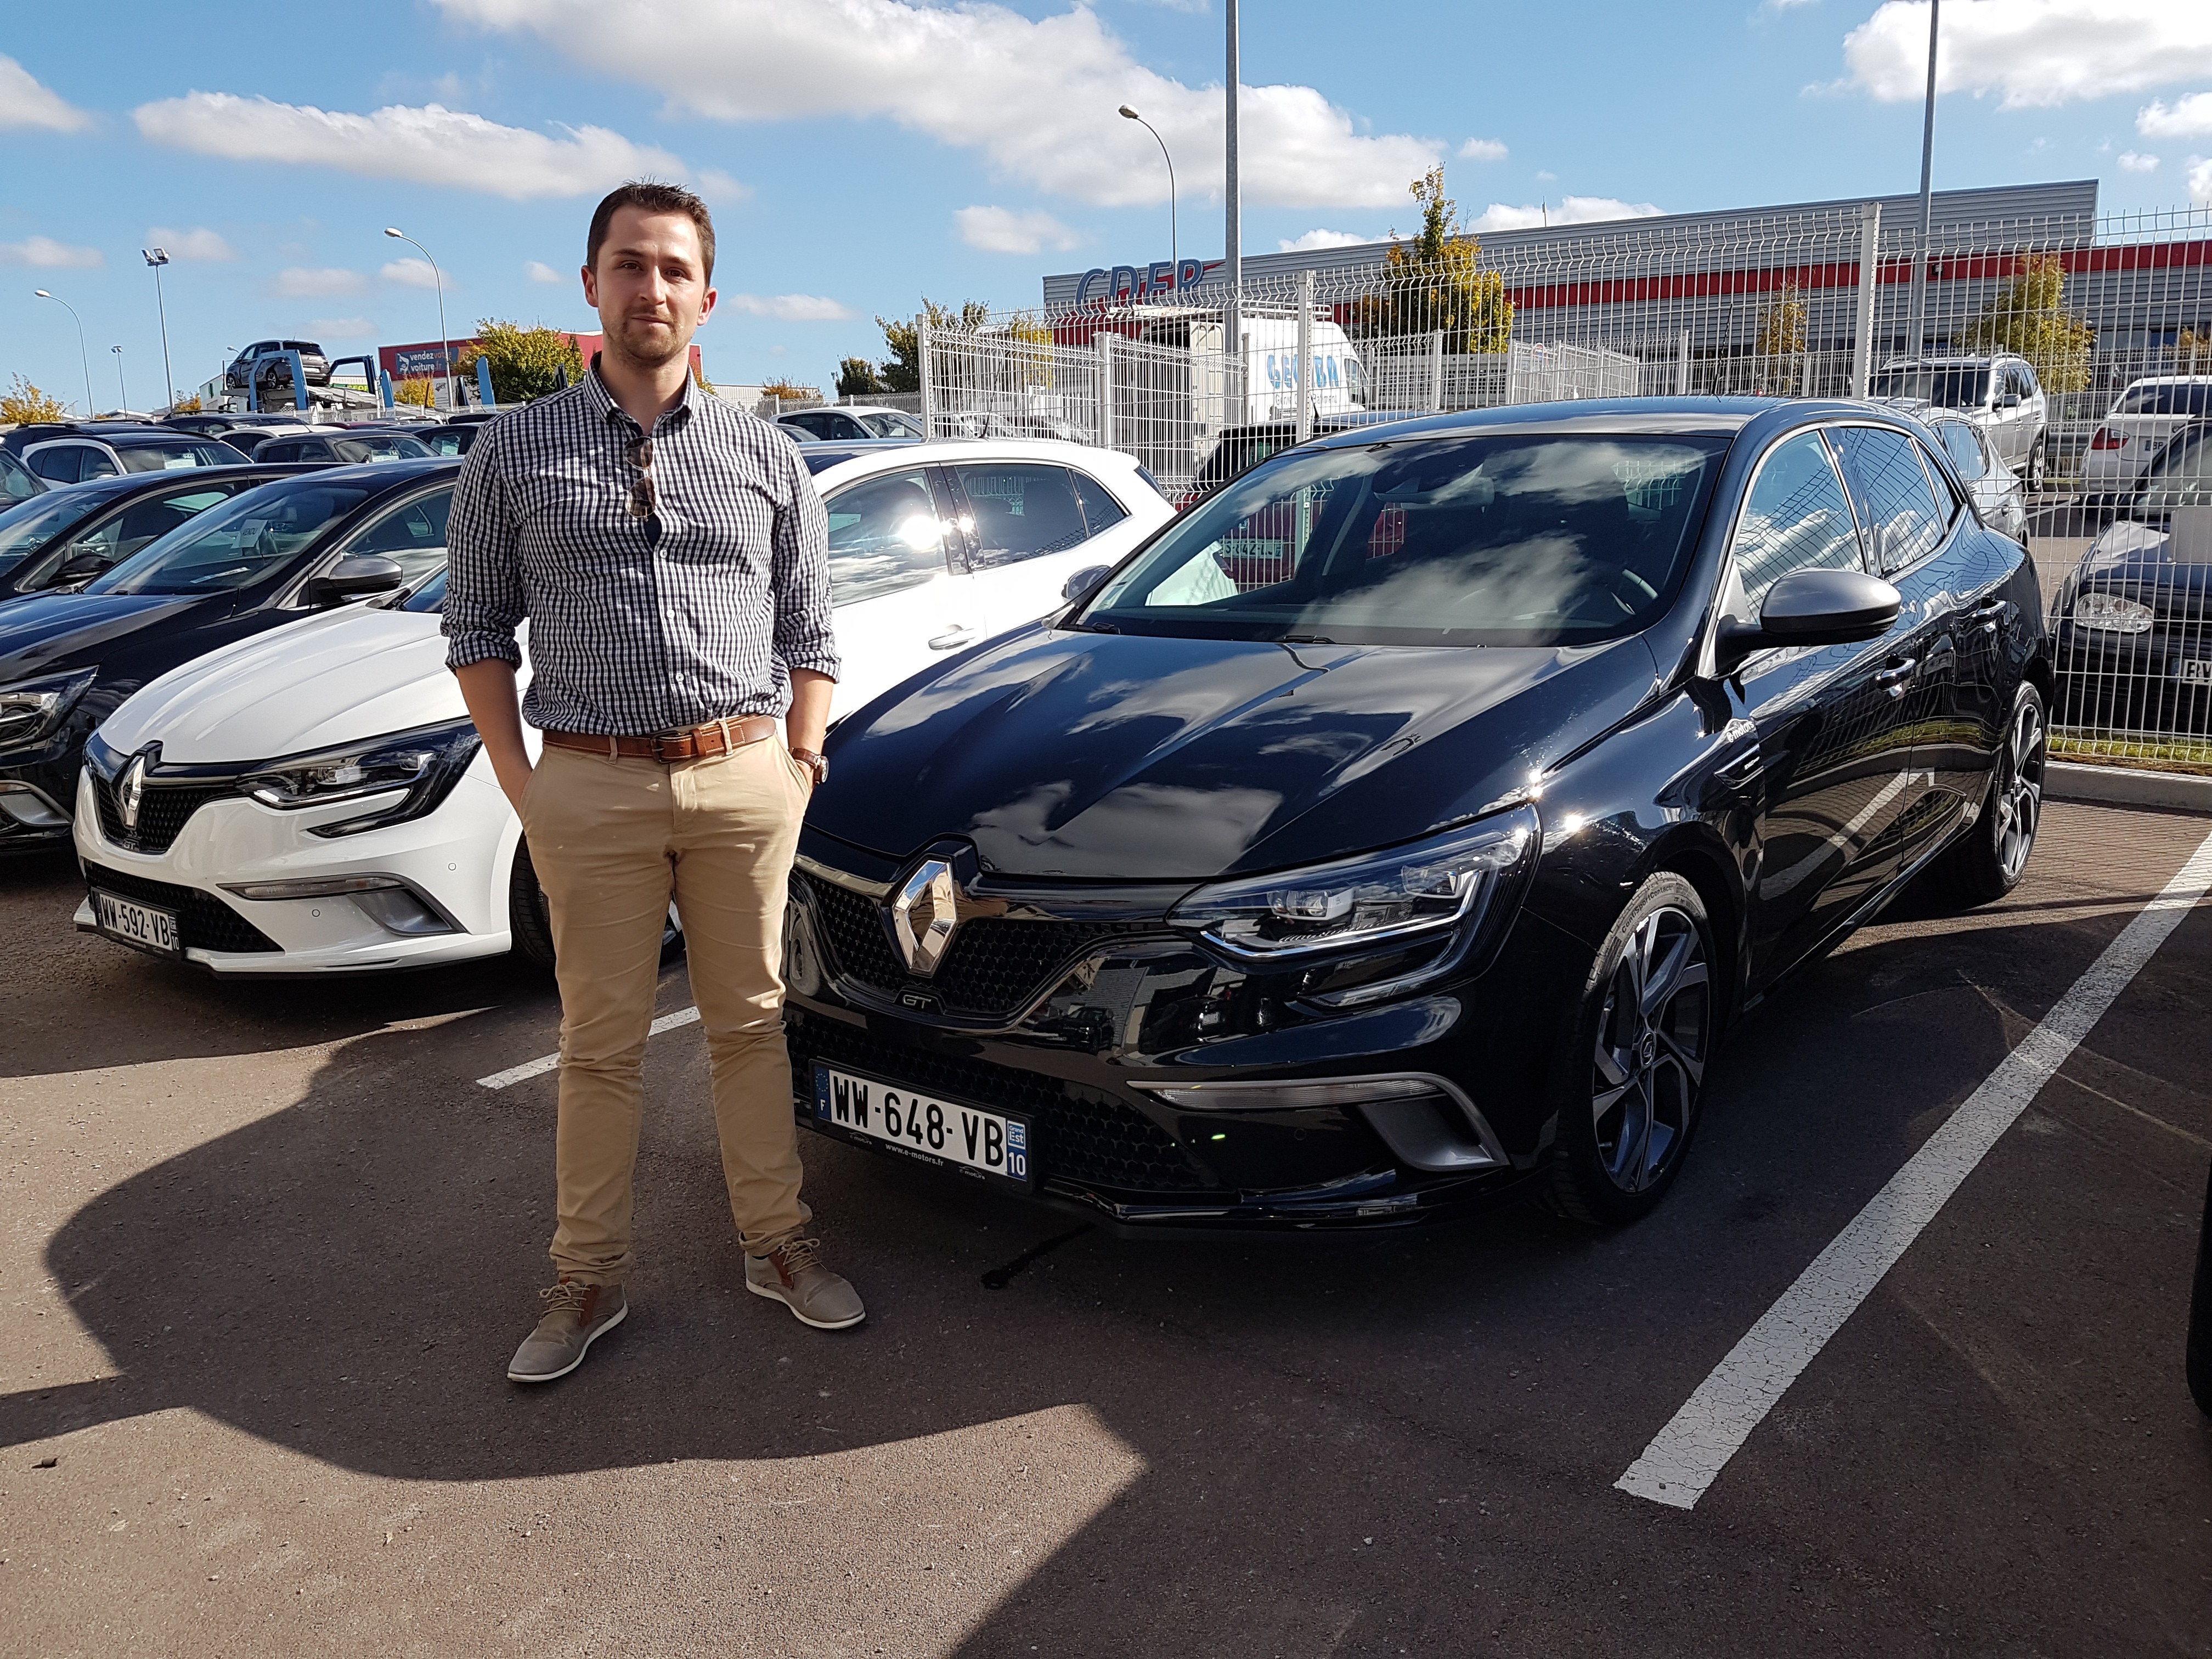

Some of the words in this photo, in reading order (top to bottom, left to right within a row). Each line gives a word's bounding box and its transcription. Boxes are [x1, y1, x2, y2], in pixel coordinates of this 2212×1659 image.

[1075, 259, 1203, 317] CDER
[101, 896, 170, 951] WW-592-VB
[172, 935, 179, 950] 10
[902, 994, 932, 1009] GT
[820, 1099, 826, 1110] F
[833, 1075, 1003, 1167] WW-648-VB
[1009, 1125, 1023, 1134] Grand
[1009, 1131, 1024, 1144] Est
[885, 1144, 944, 1166] www.e-motors.fr
[1009, 1152, 1025, 1176] 10
